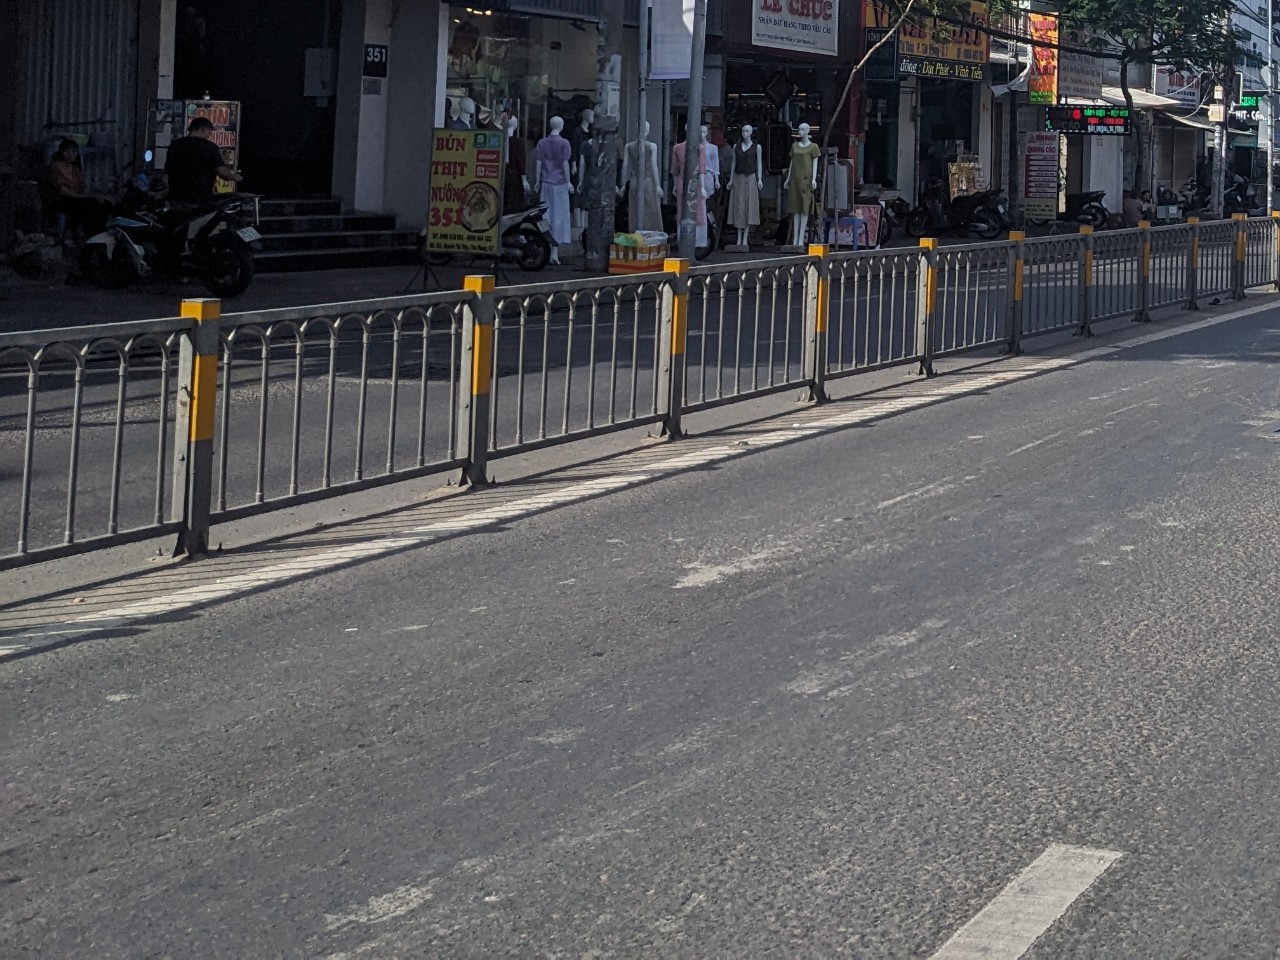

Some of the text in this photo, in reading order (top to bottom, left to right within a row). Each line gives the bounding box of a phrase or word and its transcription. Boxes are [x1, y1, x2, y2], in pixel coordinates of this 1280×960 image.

[366, 47, 386, 62] 351
[436, 134, 466, 151] BÚN
[432, 160, 467, 180] THỊT
